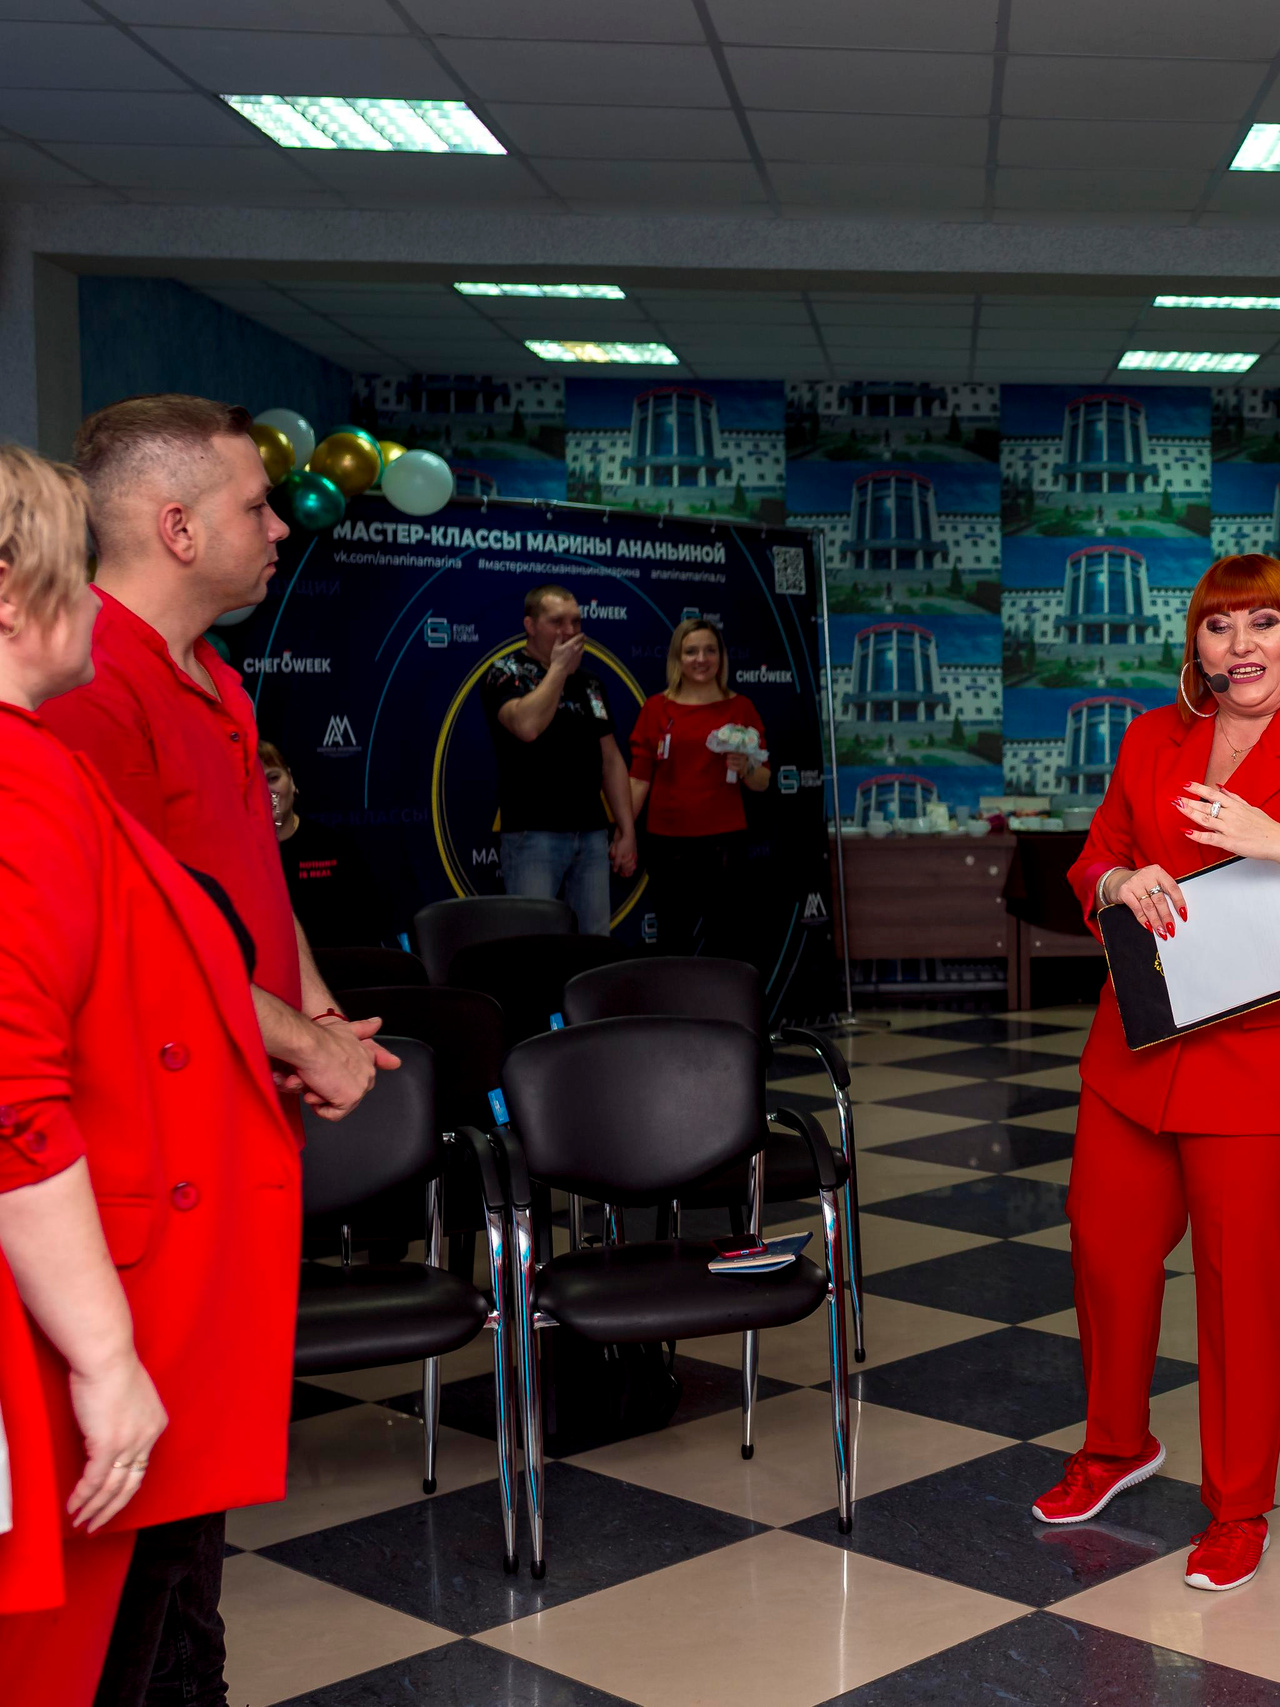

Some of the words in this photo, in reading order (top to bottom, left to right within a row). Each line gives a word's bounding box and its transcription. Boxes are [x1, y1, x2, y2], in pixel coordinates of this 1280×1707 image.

[332, 519, 522, 551] МАСТЕР-КЛАССЫ
[526, 531, 613, 558] МАРИНЫ
[616, 539, 727, 565] АНАНЬИНОЙ
[333, 549, 463, 570] vk.com/ananinamarina
